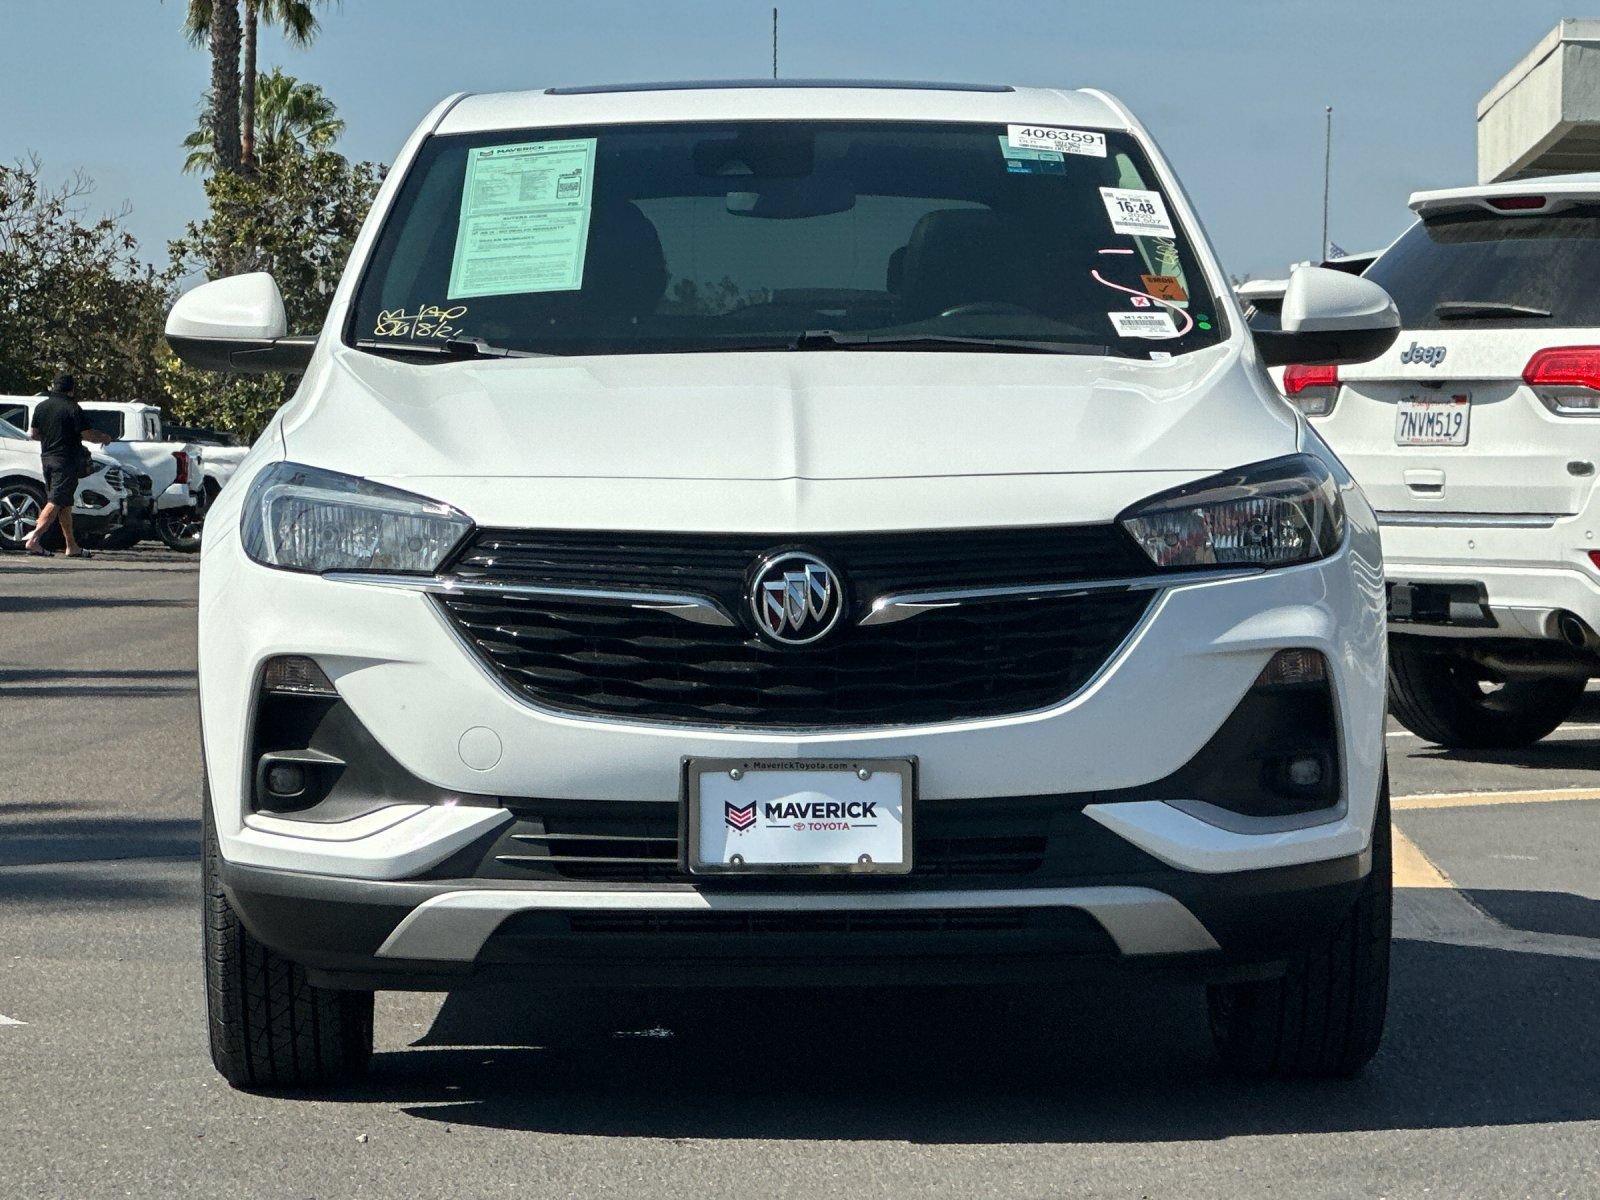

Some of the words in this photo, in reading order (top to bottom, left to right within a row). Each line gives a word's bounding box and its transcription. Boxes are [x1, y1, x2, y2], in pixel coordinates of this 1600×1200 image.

[1021, 128, 1103, 145] 4063591
[496, 145, 545, 155] MAVERICK
[1116, 201, 1155, 214] 16:48
[1400, 341, 1447, 368] Jeep
[1400, 411, 1463, 437] 7NVM519
[753, 762, 848, 770] MaverickToyota.com
[765, 801, 877, 819] MAVERICK
[808, 822, 850, 831] TOYOTA
